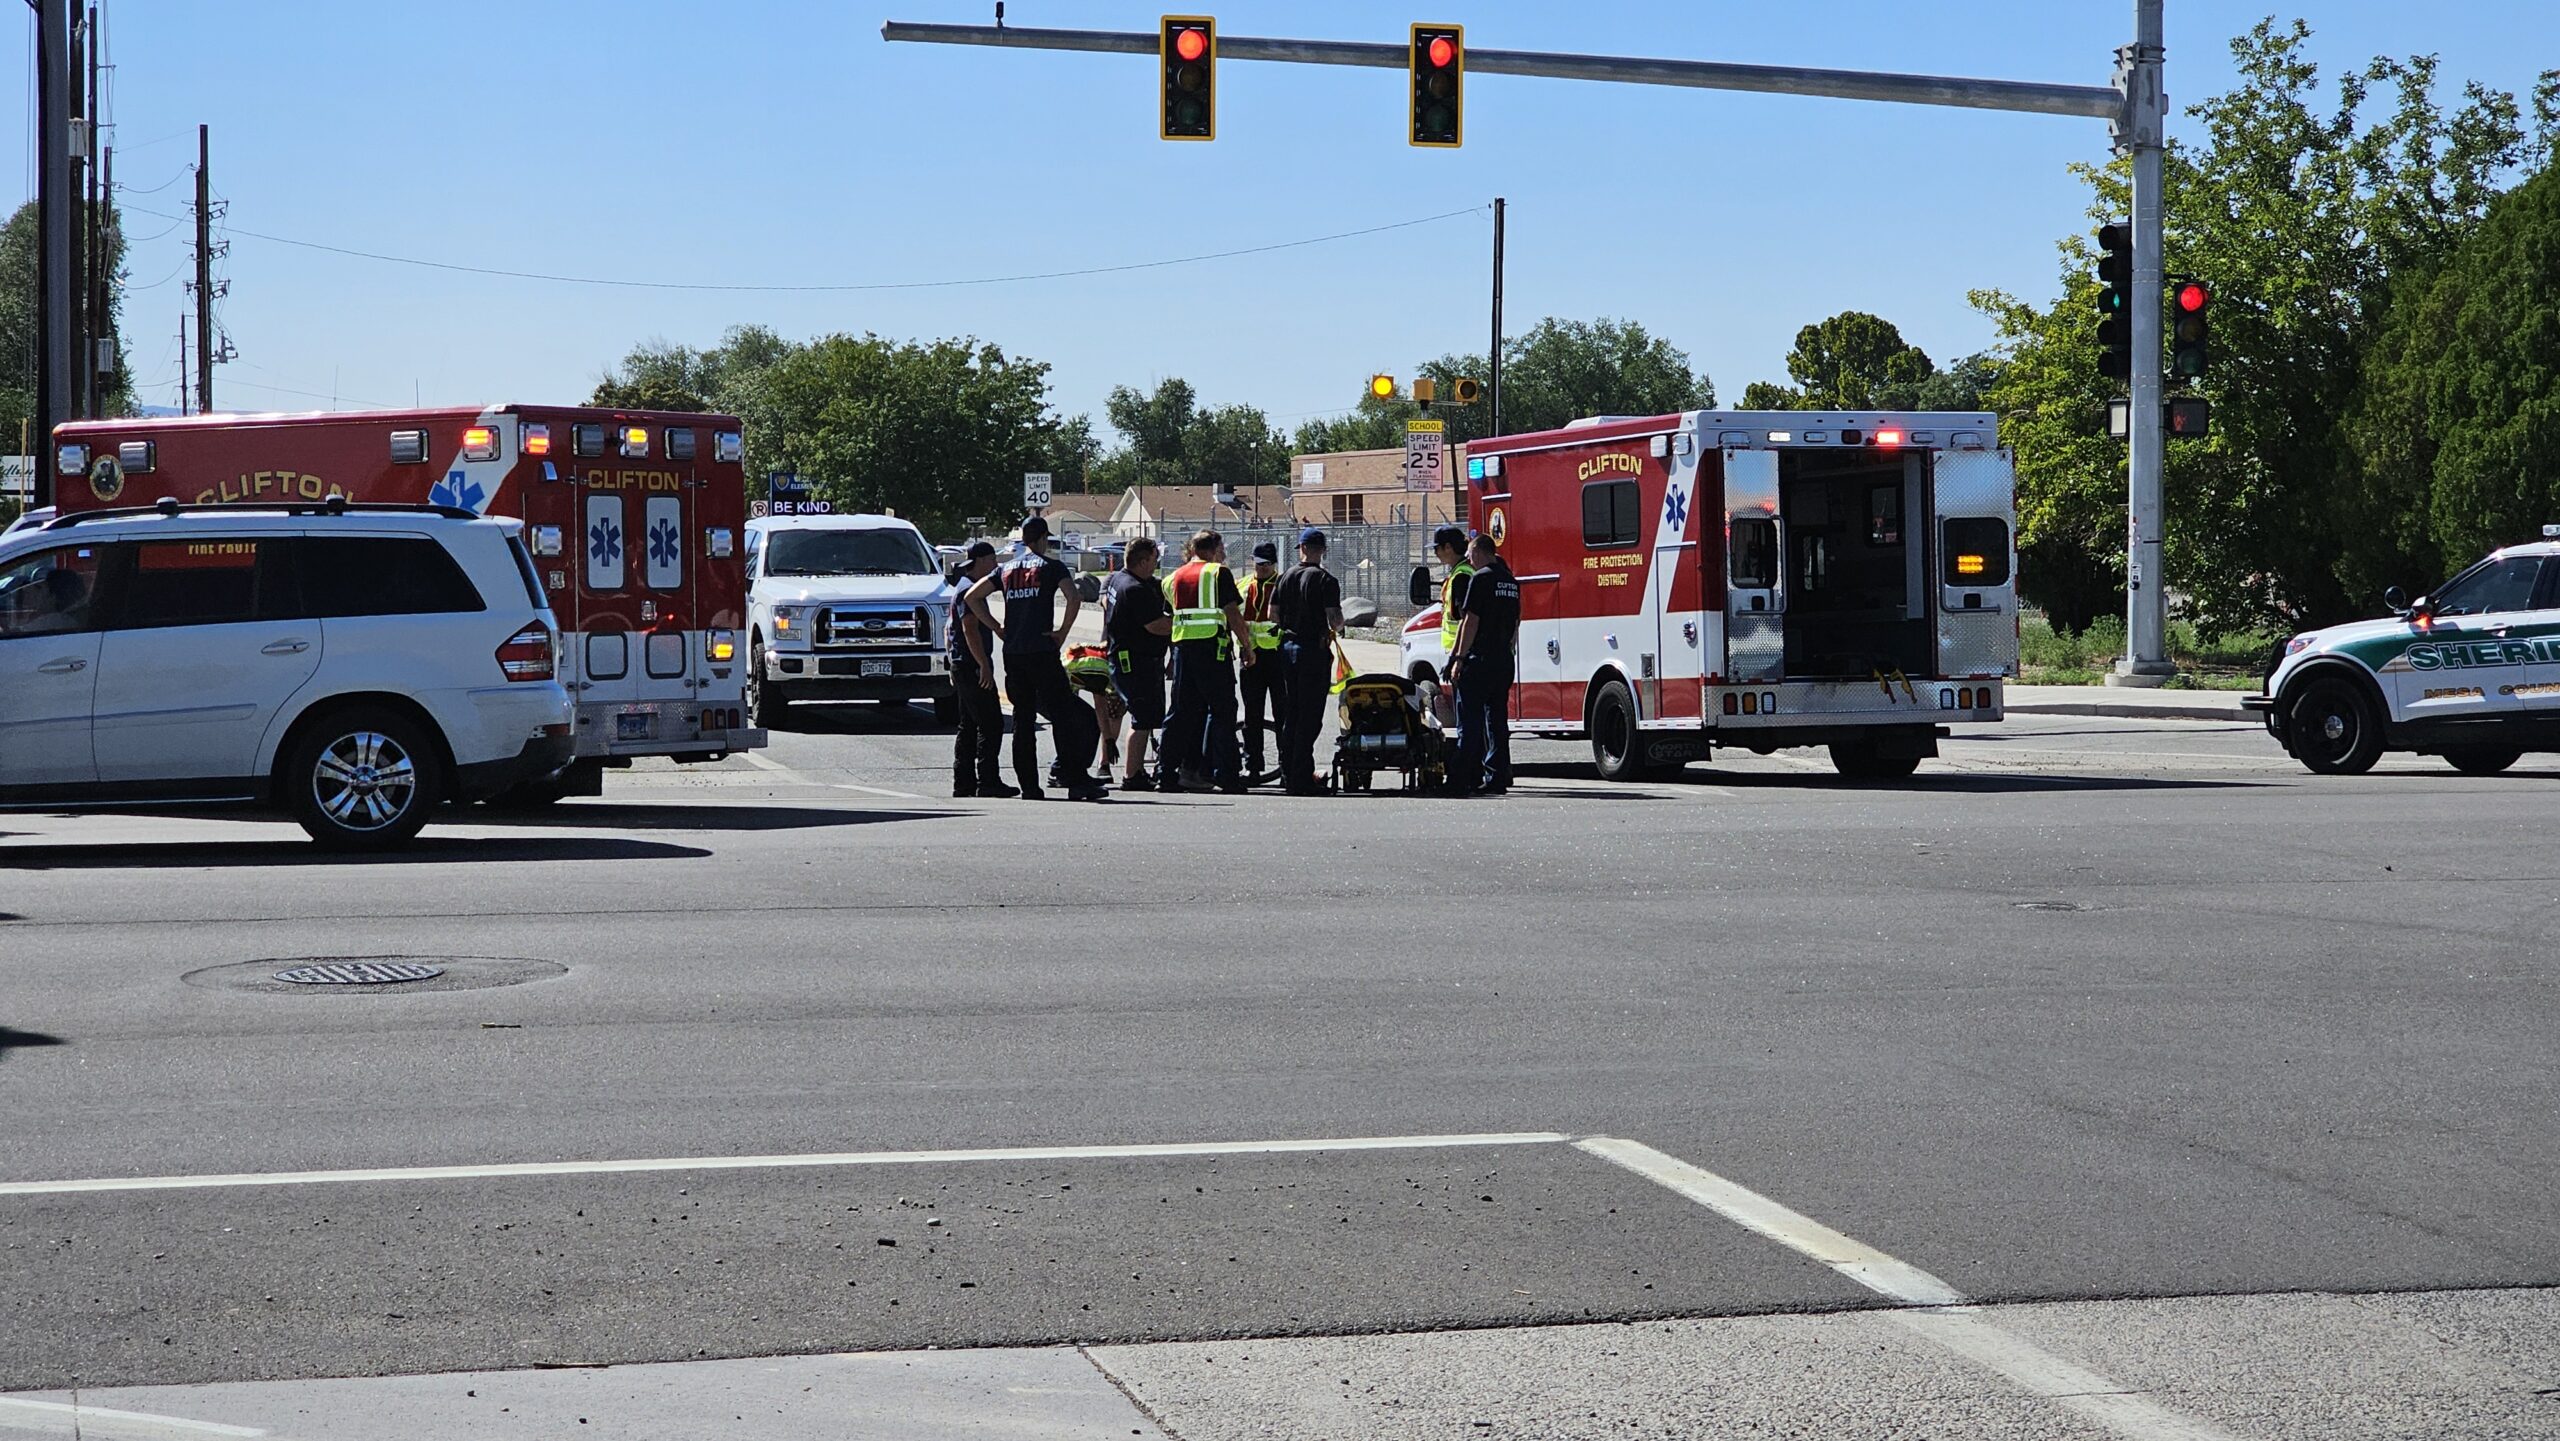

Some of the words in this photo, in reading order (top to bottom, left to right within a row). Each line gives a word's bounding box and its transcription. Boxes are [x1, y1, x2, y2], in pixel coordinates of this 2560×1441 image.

[1409, 422, 1441, 430] SCHOOL
[1410, 434, 1440, 442] SPEED
[1413, 443, 1437, 451] LIMIT
[1410, 452, 1440, 469] 25
[1578, 453, 1642, 481] CLIFTON
[588, 469, 679, 490] CLIFTON
[1027, 491, 1050, 504] 40
[774, 502, 793, 513] BE
[797, 502, 831, 513] KIND
[1583, 557, 1599, 569] FIRE
[1600, 554, 1643, 567] PROTECTION
[1598, 573, 1628, 586] DISTRICT
[2406, 636, 2560, 671] SHERI
[2424, 687, 2485, 699] MESA
